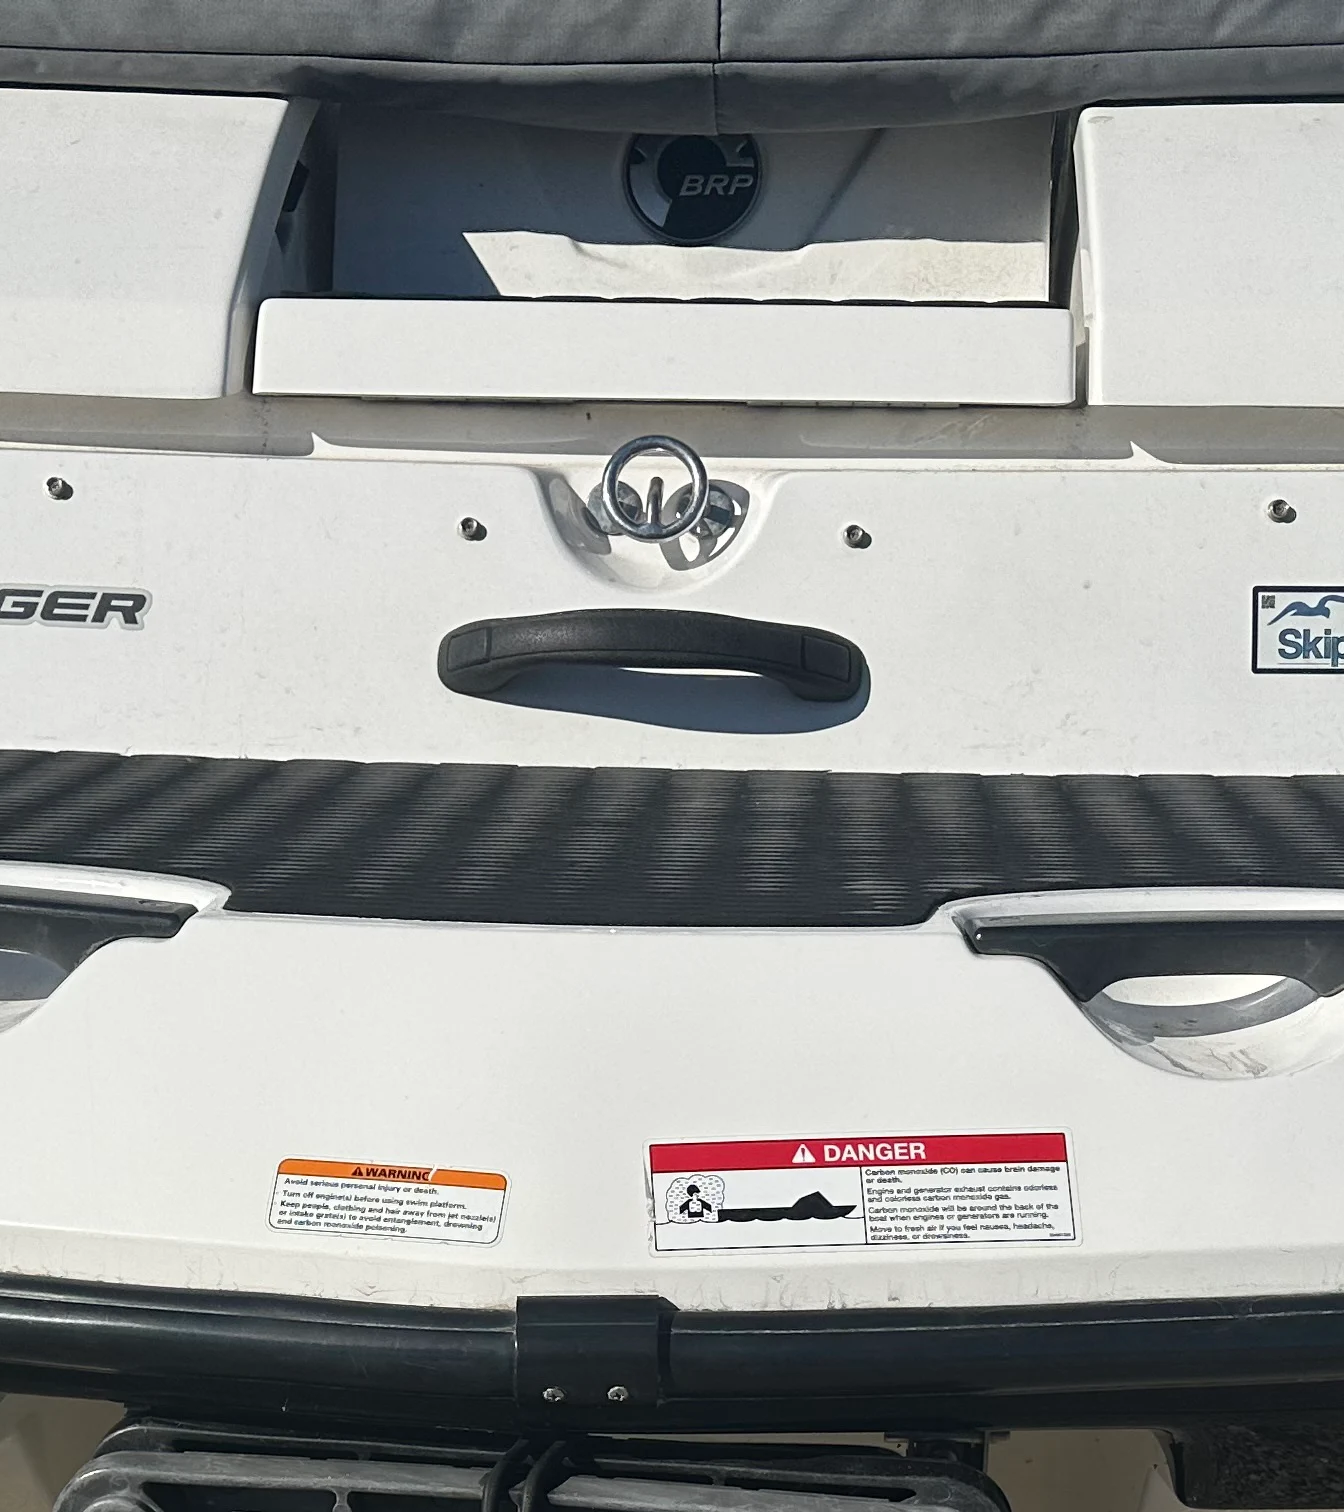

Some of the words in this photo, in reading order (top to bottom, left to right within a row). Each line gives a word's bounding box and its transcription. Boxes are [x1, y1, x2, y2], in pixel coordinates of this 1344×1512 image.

[679, 174, 753, 196] BRP
[824, 1142, 926, 1162] DANGER
[940, 1167, 958, 1175] (CO)
[1027, 1166, 1060, 1174] damage
[341, 1183, 376, 1191] personal
[378, 1184, 401, 1193] injury
[867, 1188, 894, 1196] Engine
[913, 1187, 952, 1195] generator
[954, 1185, 985, 1193] exhaust
[382, 1198, 404, 1206] using
[281, 1200, 300, 1209] Keep
[334, 1204, 366, 1213] clothing
[385, 1207, 401, 1215] hair
[447, 1212, 458, 1220] jet
[913, 1214, 944, 1222] engines
[957, 1212, 1000, 1221] generators
[294, 1219, 321, 1227] carbon
[946, 1225, 961, 1233] you
